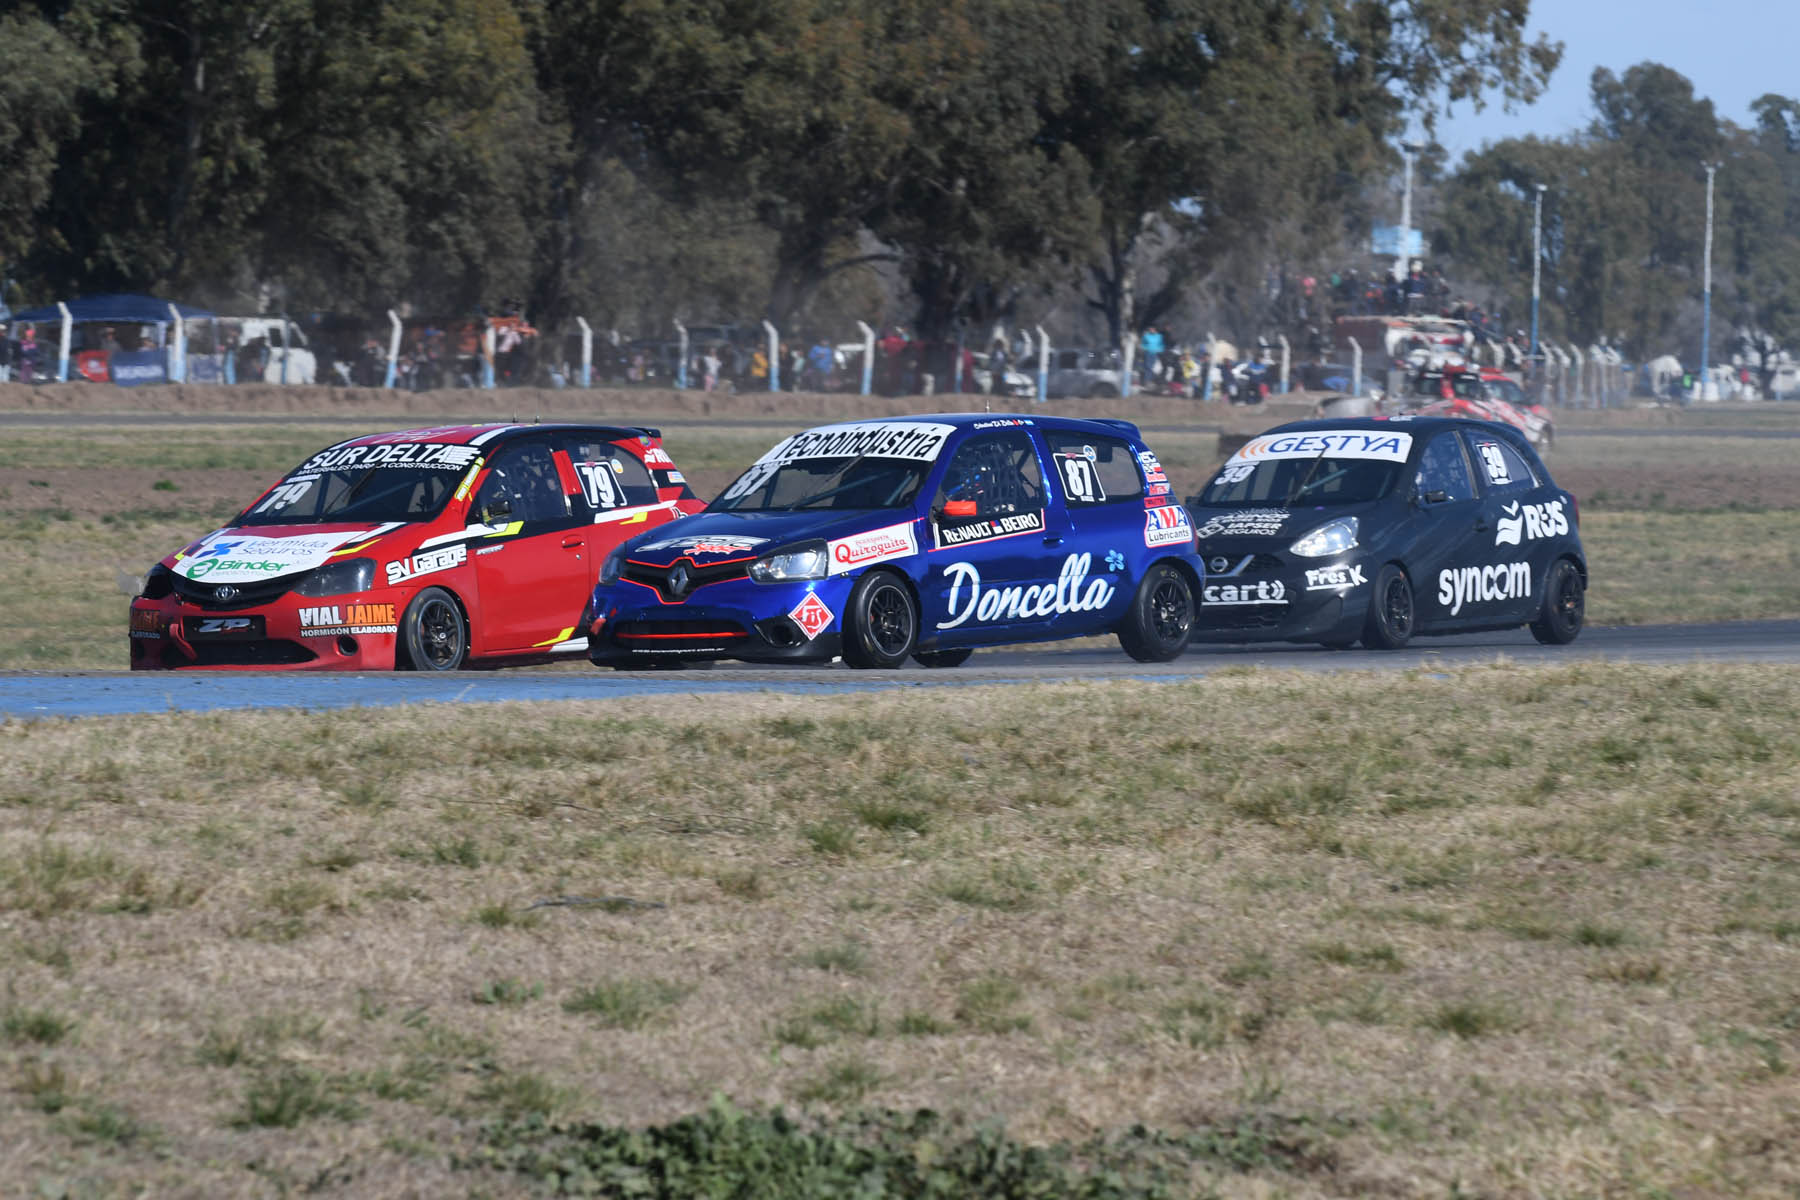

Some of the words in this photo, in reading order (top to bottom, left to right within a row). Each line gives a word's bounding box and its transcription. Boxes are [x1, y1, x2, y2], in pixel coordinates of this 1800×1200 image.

[775, 425, 942, 459] Tecnoindustria
[1268, 435, 1400, 453] GESTYA
[304, 446, 364, 470] SUR
[362, 444, 451, 463] DELTA
[1482, 446, 1507, 478] 39
[581, 466, 615, 503] 79
[724, 464, 781, 500] 87
[1065, 459, 1094, 496] 87
[1214, 465, 1255, 485] 39
[255, 481, 313, 513] 79
[942, 521, 992, 543] RENAULT
[1000, 513, 1040, 532] BEIRO
[1148, 506, 1188, 530] AMA
[1149, 529, 1190, 542] Lubricants
[413, 547, 467, 572] Garage
[835, 539, 908, 563] Quiroguita
[216, 559, 291, 572] Binder
[936, 552, 1115, 630] Doncella
[1438, 562, 1532, 616] syncom
[298, 605, 343, 627] VIAL
[345, 604, 396, 624] JAIME
[301, 627, 350, 637] HORMIGÓN
[350, 625, 398, 634] ELABORADO
